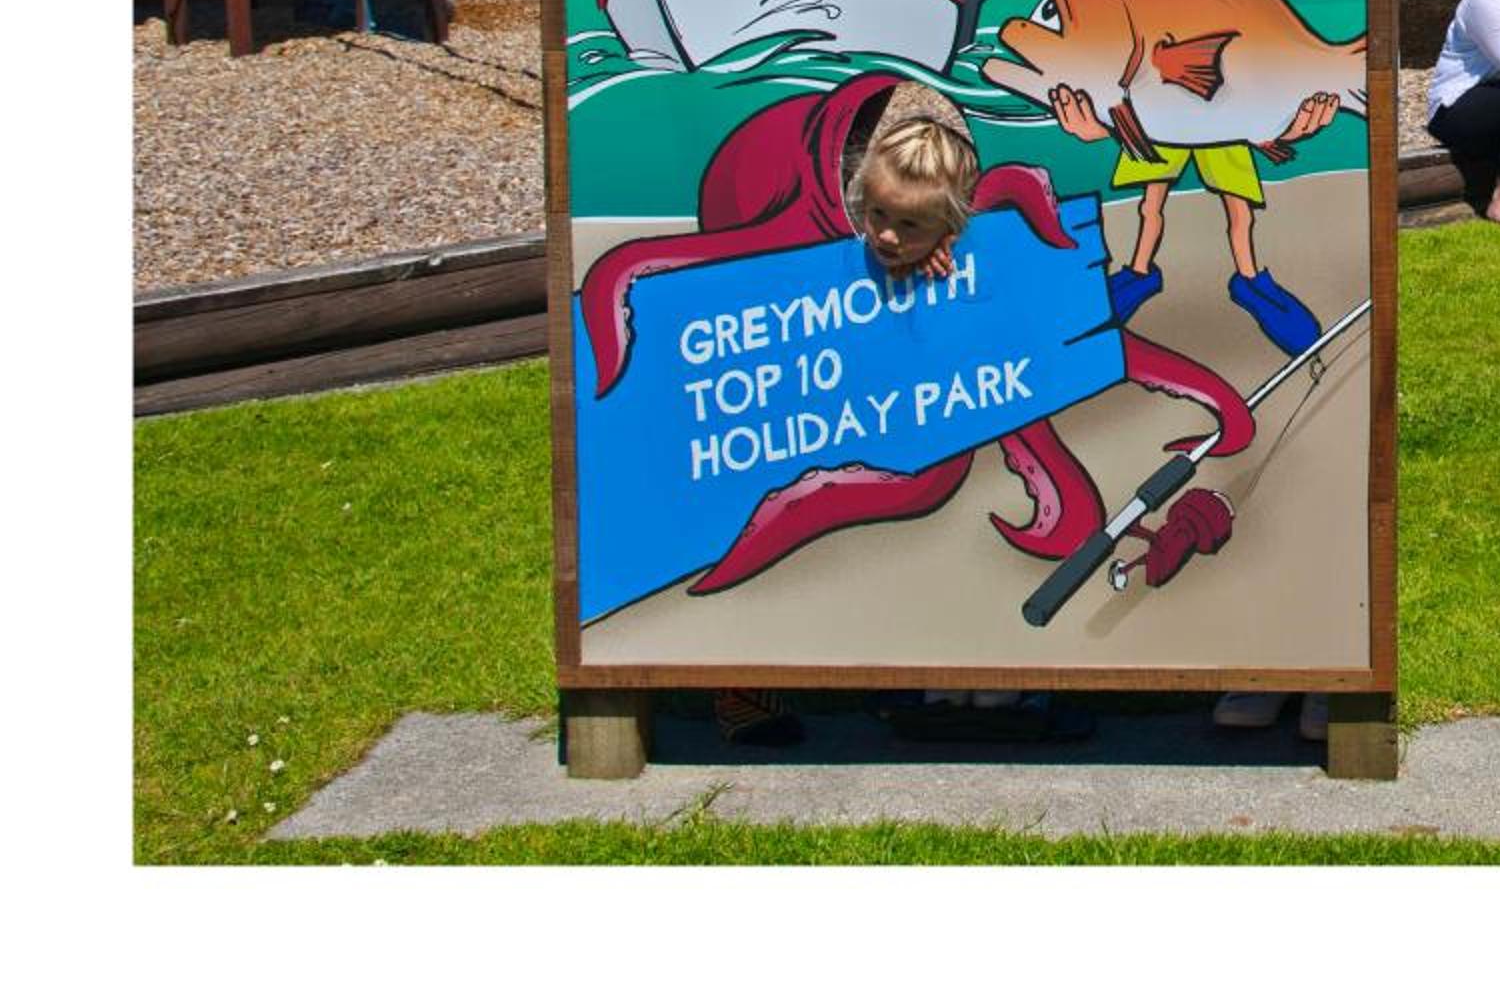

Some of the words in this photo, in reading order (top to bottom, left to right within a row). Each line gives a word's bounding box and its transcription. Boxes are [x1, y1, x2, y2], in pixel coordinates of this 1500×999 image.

[680, 252, 976, 365] GREYMOUTH
[685, 363, 782, 422] TOP
[797, 348, 843, 397] 10
[690, 390, 900, 481] HOLIDAY
[914, 357, 1034, 427] PARK
